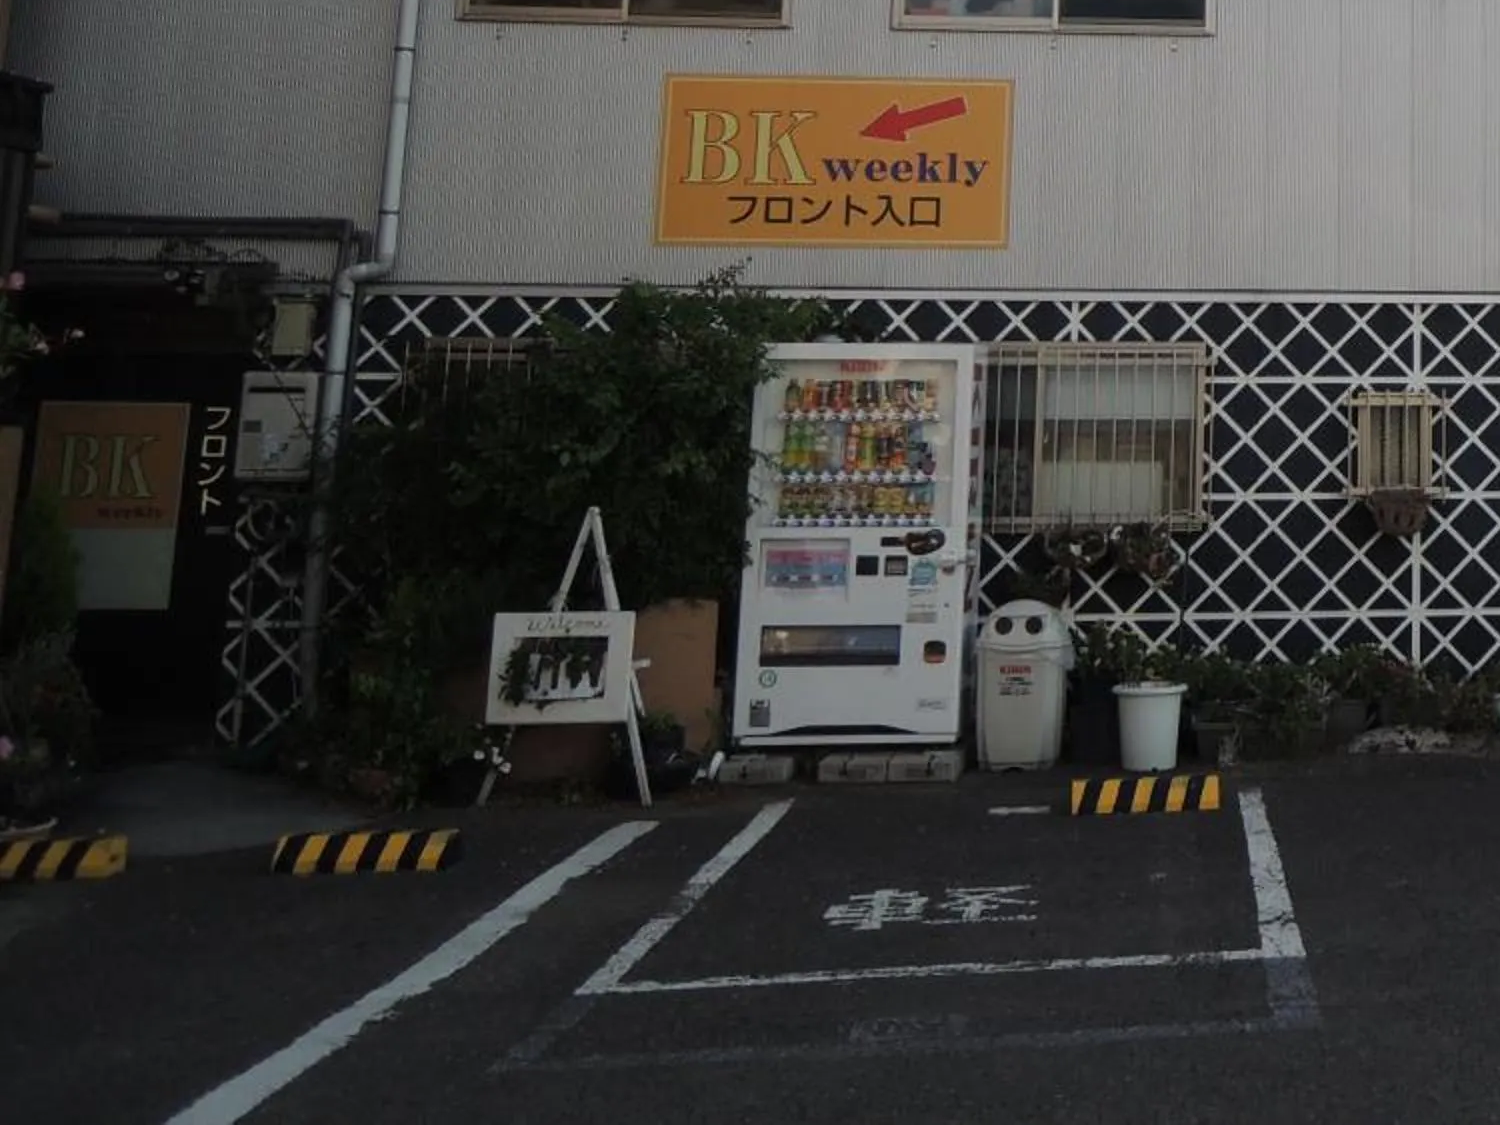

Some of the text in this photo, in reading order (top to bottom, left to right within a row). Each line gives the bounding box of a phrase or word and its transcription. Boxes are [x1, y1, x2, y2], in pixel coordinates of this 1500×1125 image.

[681, 109, 989, 187] BK weekly
[727, 195, 942, 228] フロント入口
[60, 434, 161, 499] BK
[197, 406, 232, 516] フロント
